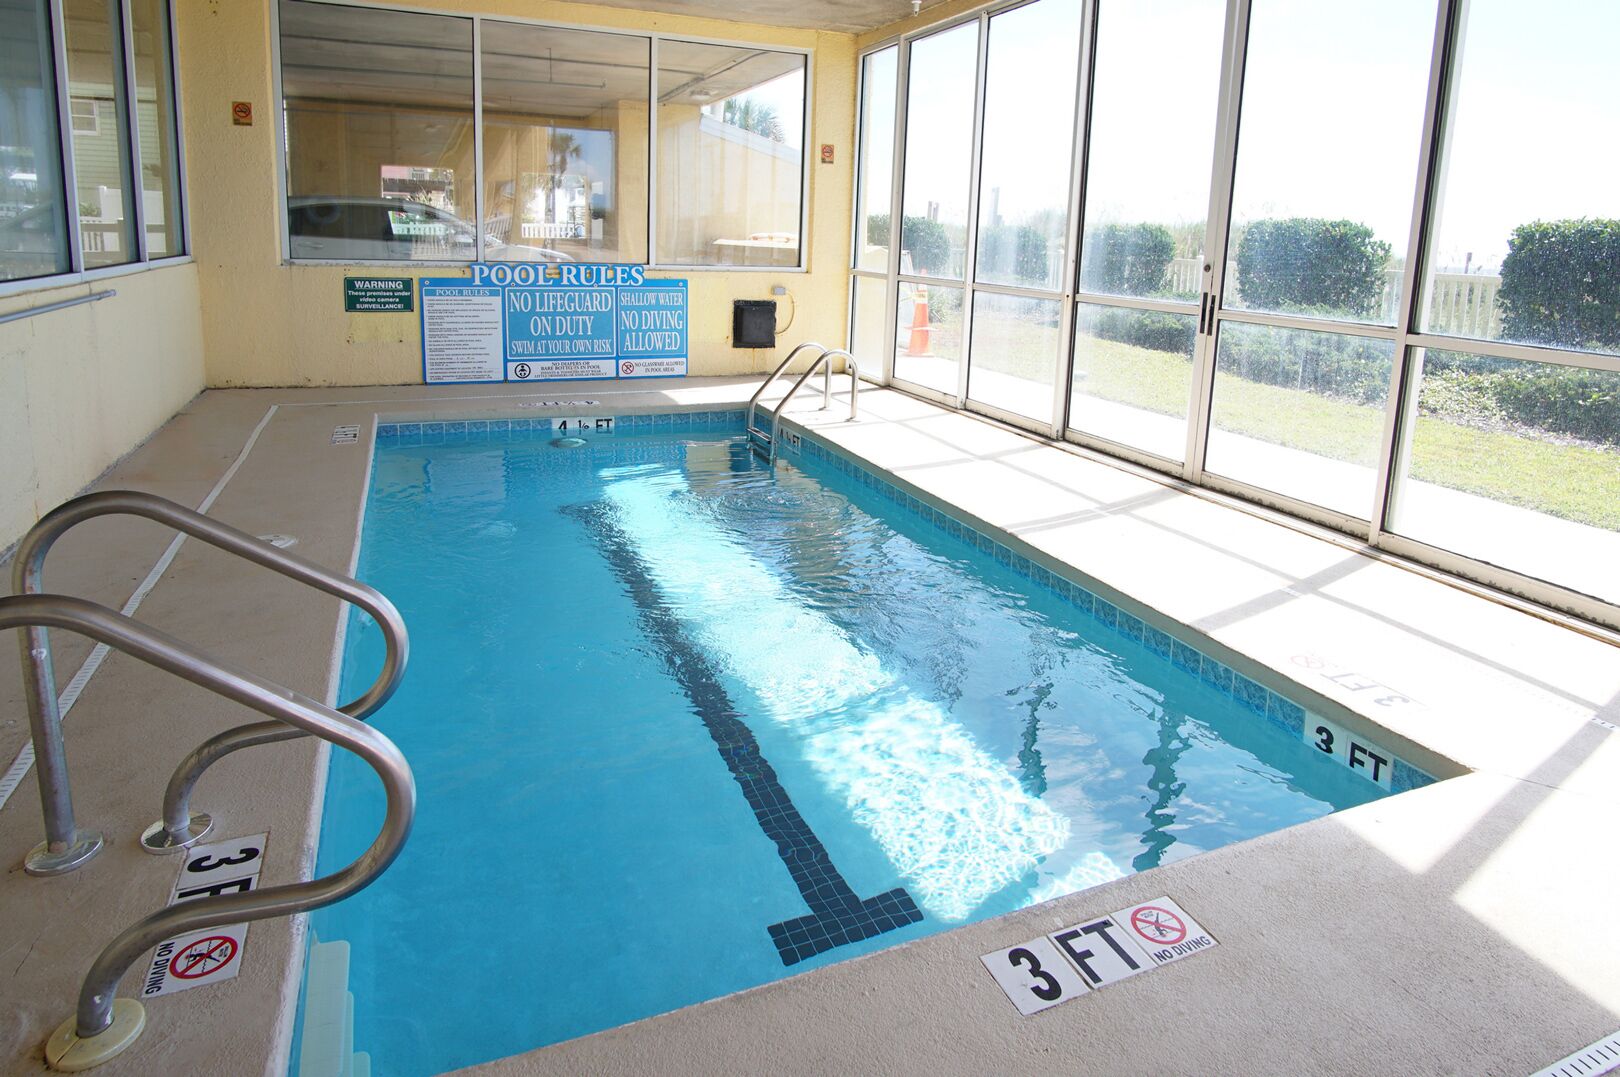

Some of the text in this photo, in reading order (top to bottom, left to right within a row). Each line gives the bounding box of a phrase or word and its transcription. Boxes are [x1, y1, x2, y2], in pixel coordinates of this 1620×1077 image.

[354, 280, 403, 289] WARNING
[472, 265, 645, 286] POOL RULES
[509, 292, 612, 312] NO LIFEGUARD
[620, 292, 683, 306] SHALLOW WATER
[530, 315, 594, 336] ON DUTY
[621, 310, 683, 330] NO DIVING
[511, 339, 612, 355] SWIM AT YOUR OWN RISK
[624, 331, 680, 351] ALLOWED
[595, 418, 612, 429] FT
[1314, 725, 1388, 782] 3 FT
[187, 847, 260, 873] 3
[1153, 935, 1212, 963] NO DIVING
[144, 941, 175, 995] NO DIVING
[1008, 919, 1141, 1002] 3 FT
